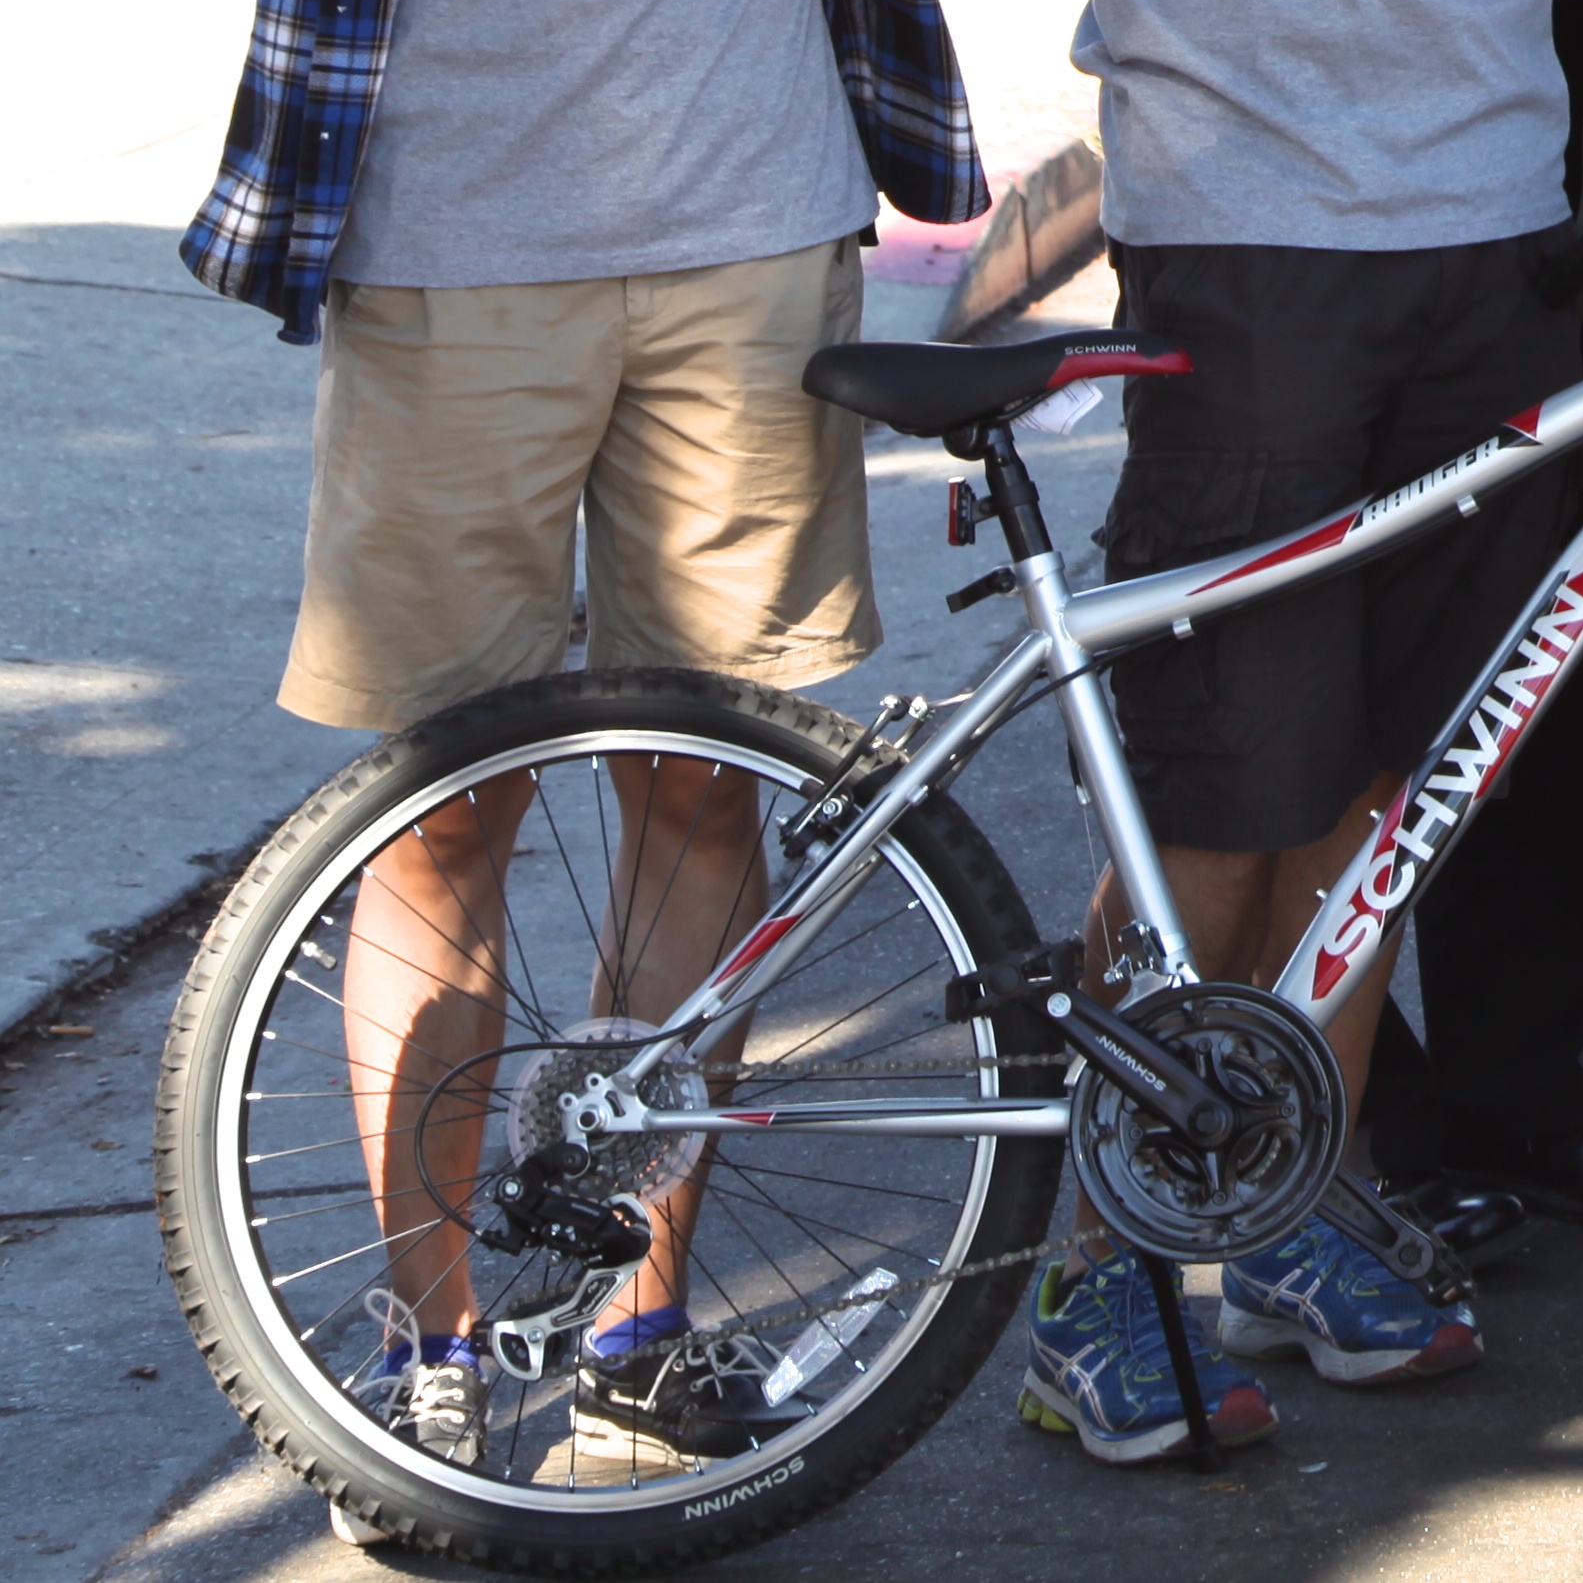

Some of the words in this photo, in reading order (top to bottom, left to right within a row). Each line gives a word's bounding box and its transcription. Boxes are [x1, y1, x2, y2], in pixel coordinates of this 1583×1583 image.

[1064, 343, 1137, 356] SCHWINN
[1363, 433, 1501, 522] RANGER
[1095, 1034, 1167, 1093] SCHWINN
[684, 1456, 805, 1521] SCHWINN
